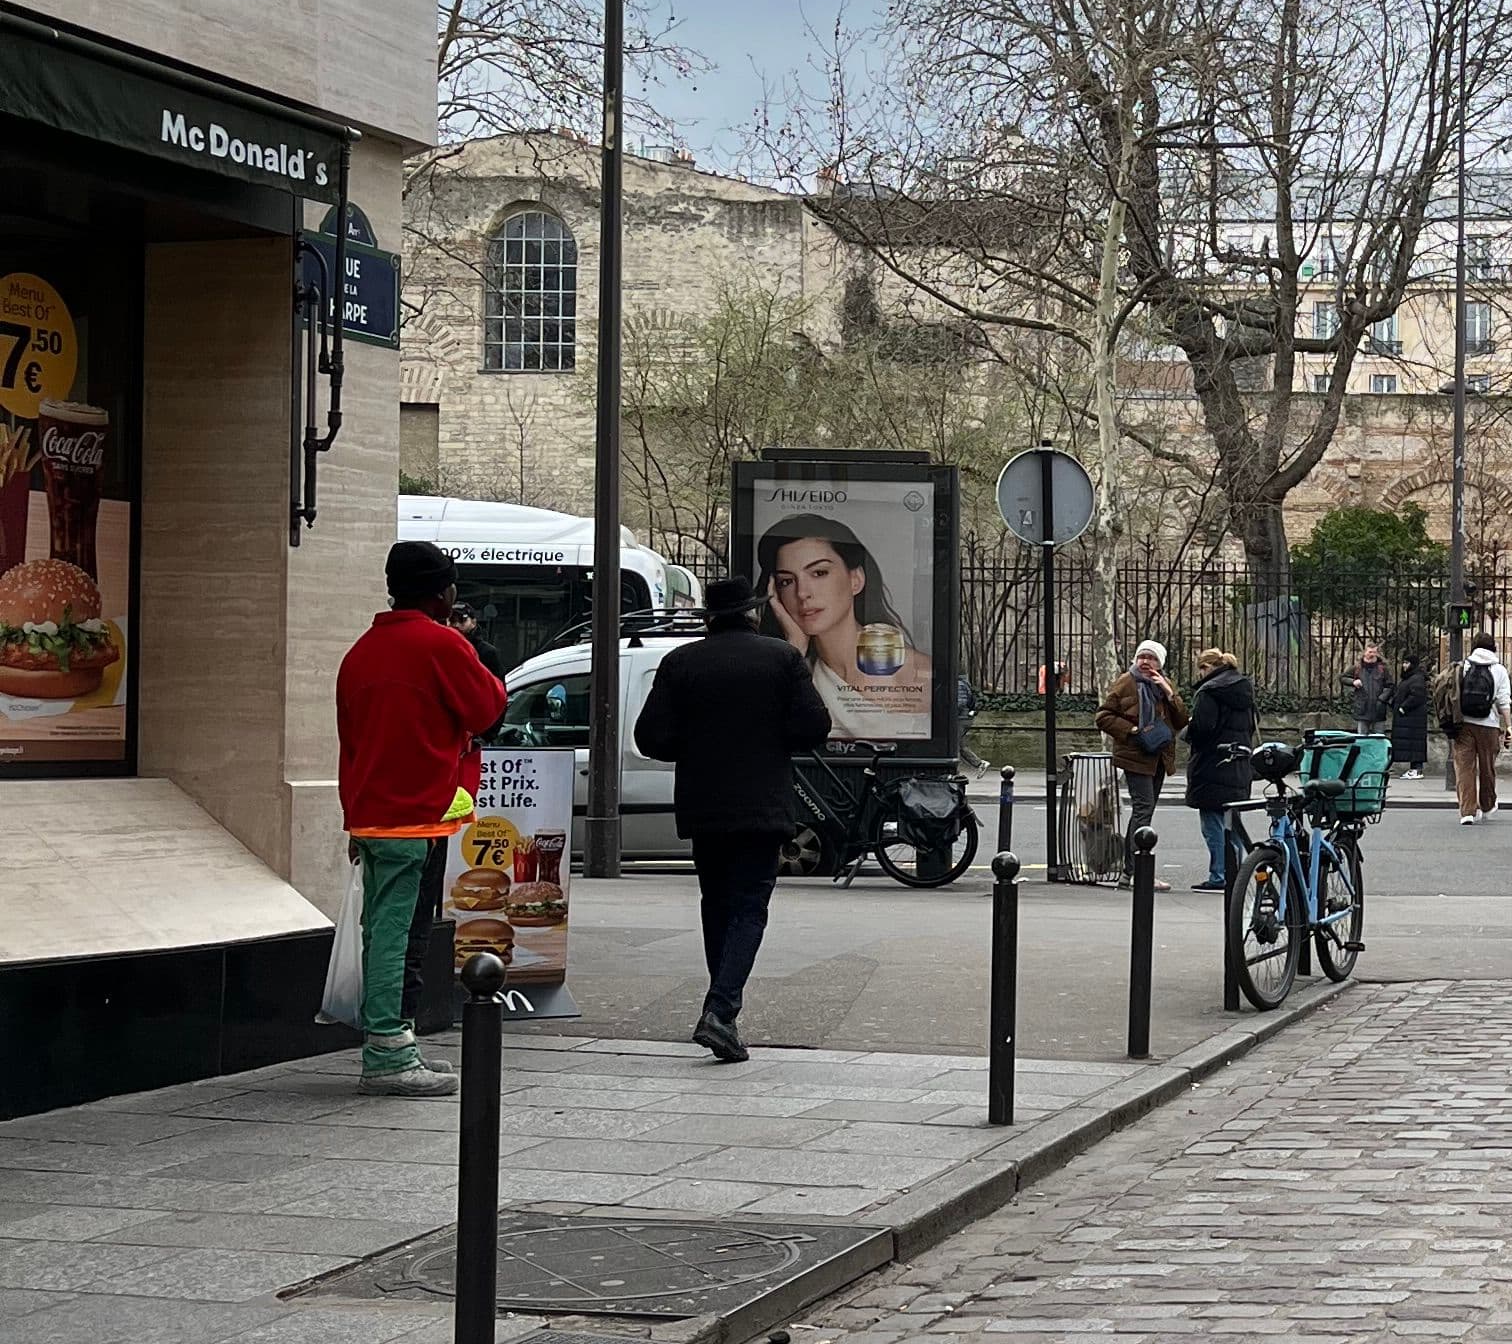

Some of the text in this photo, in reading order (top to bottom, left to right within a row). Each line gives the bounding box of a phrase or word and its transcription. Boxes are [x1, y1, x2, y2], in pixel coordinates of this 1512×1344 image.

[345, 257, 361, 279] UE
[9, 283, 45, 303] Menu
[3, 297, 33, 319] Best
[764, 487, 848, 503] SHISEIDO
[480, 546, 565, 565] électrique
[837, 685, 923, 693] VITAL PERFECTION
[502, 775, 540, 791] Prix.
[501, 792, 537, 808] Life.
